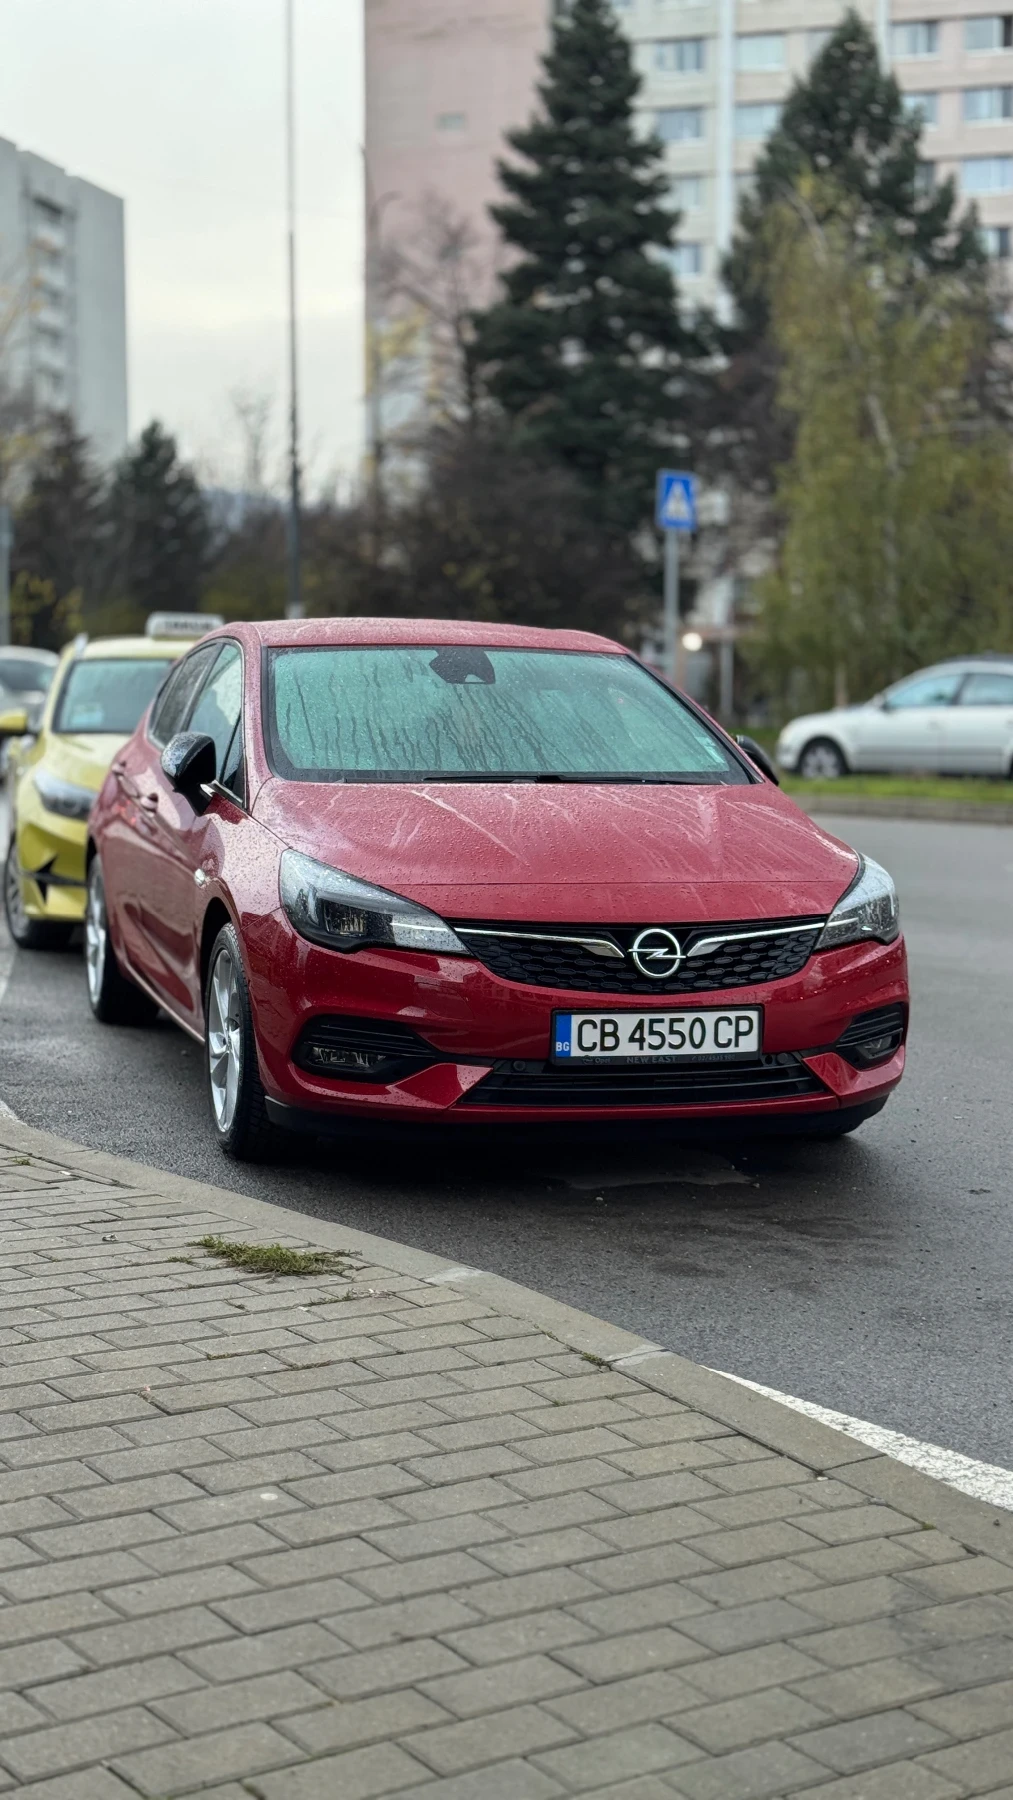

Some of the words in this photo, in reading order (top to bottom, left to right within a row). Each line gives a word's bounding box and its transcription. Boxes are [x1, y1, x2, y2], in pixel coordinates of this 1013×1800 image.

[577, 1019, 620, 1051] CB
[628, 1016, 706, 1051] 4550
[714, 1015, 754, 1048] CP
[556, 1042, 570, 1052] BG
[626, 1056, 649, 1064] NEW
[651, 1055, 677, 1063] EAST
